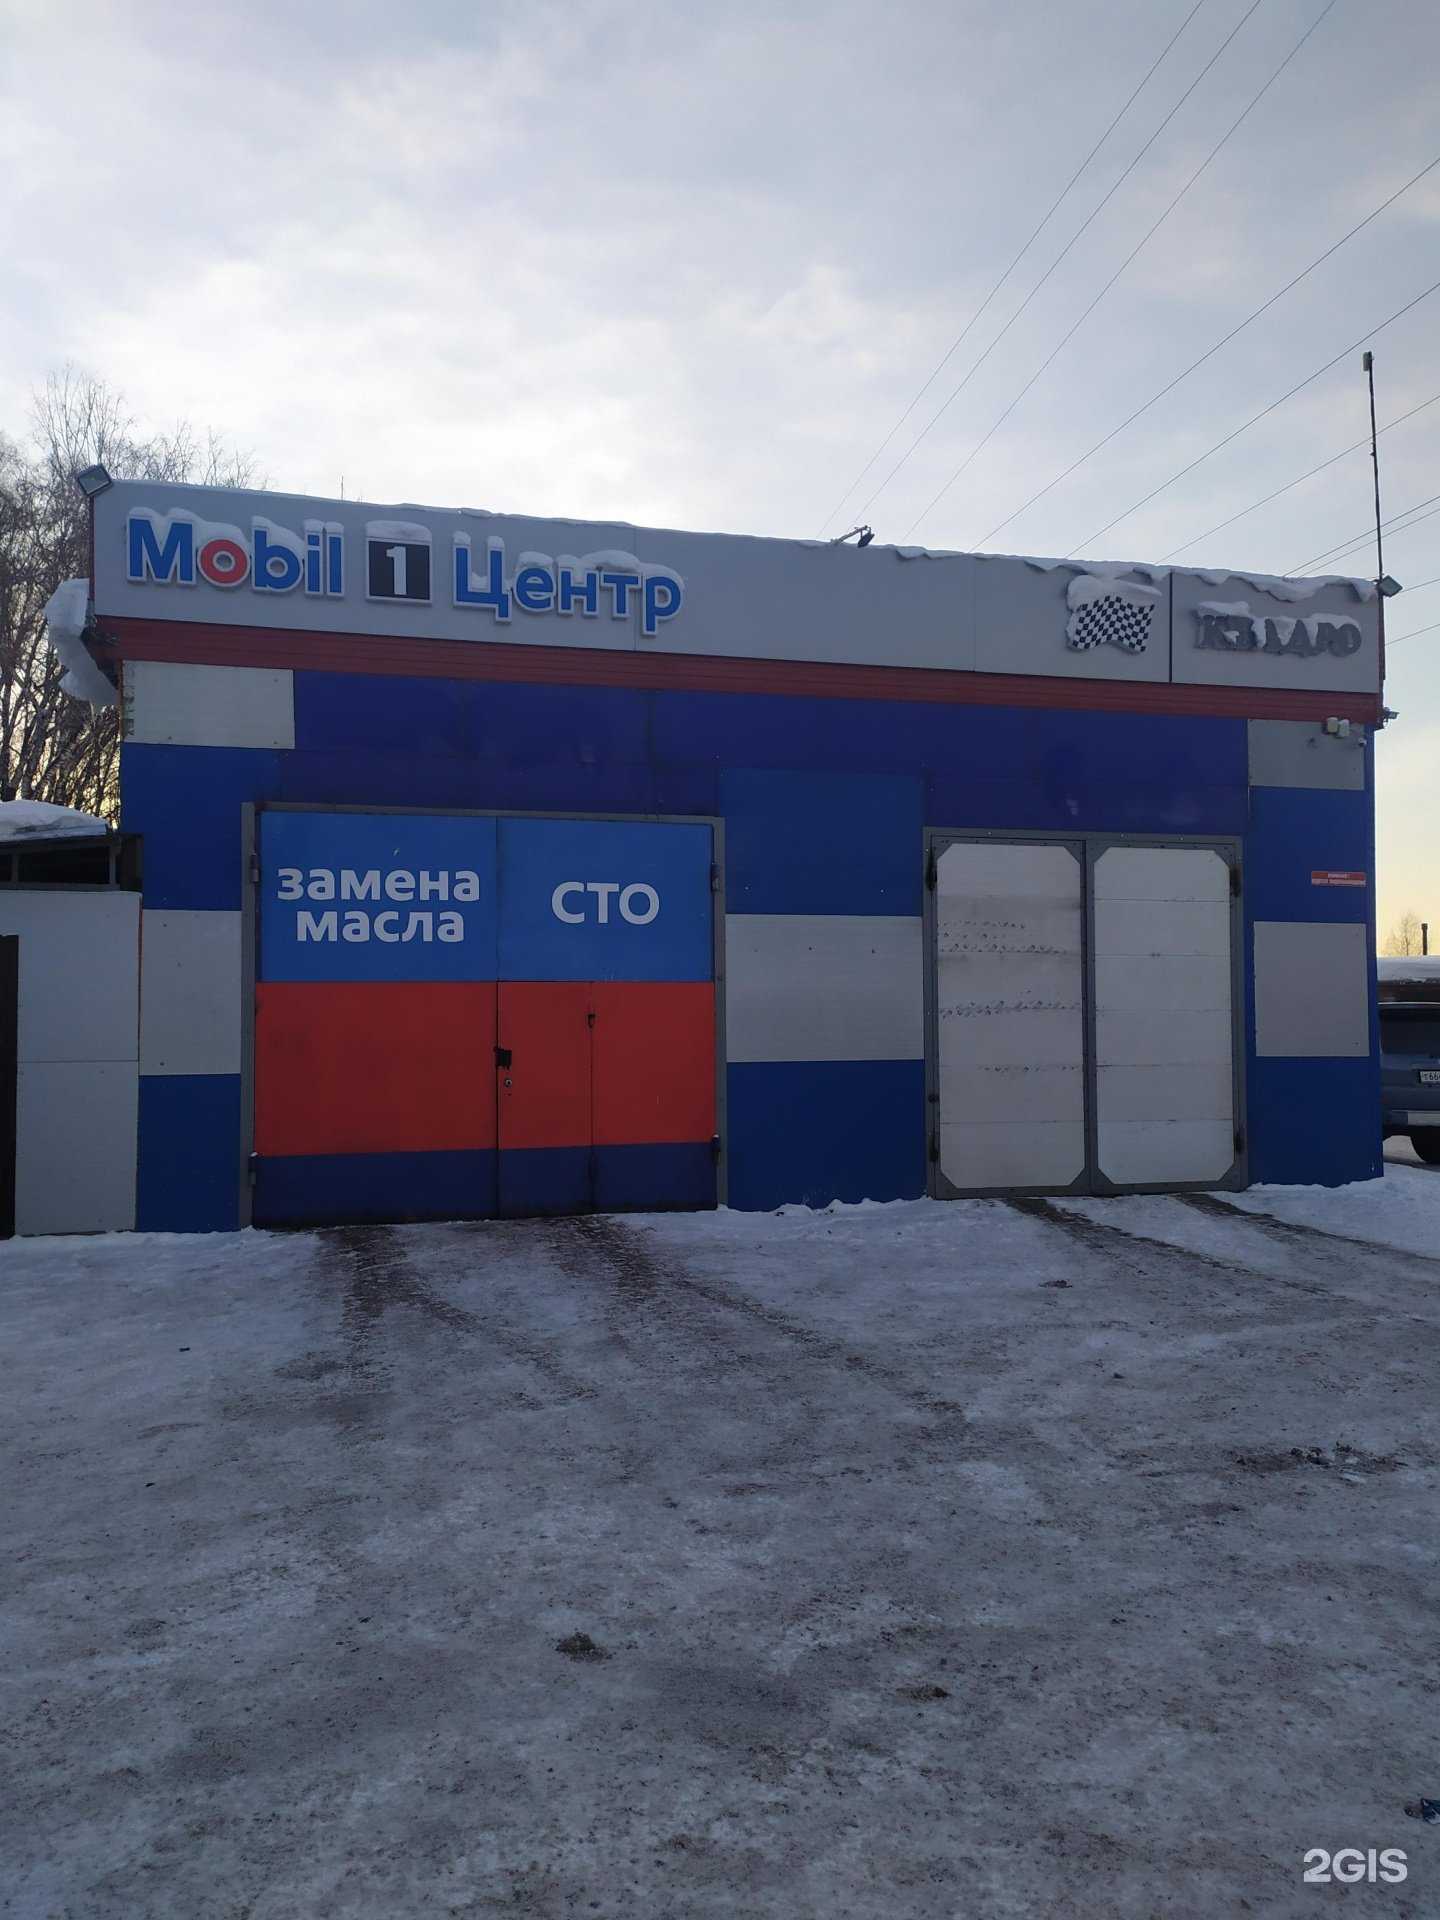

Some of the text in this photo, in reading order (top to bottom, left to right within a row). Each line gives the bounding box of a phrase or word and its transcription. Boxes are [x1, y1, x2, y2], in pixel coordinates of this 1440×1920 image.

[126, 511, 344, 597] Mobil
[453, 537, 685, 636] Центр
[277, 867, 480, 902] замена
[551, 881, 660, 925] СТО
[296, 910, 465, 943] масла
